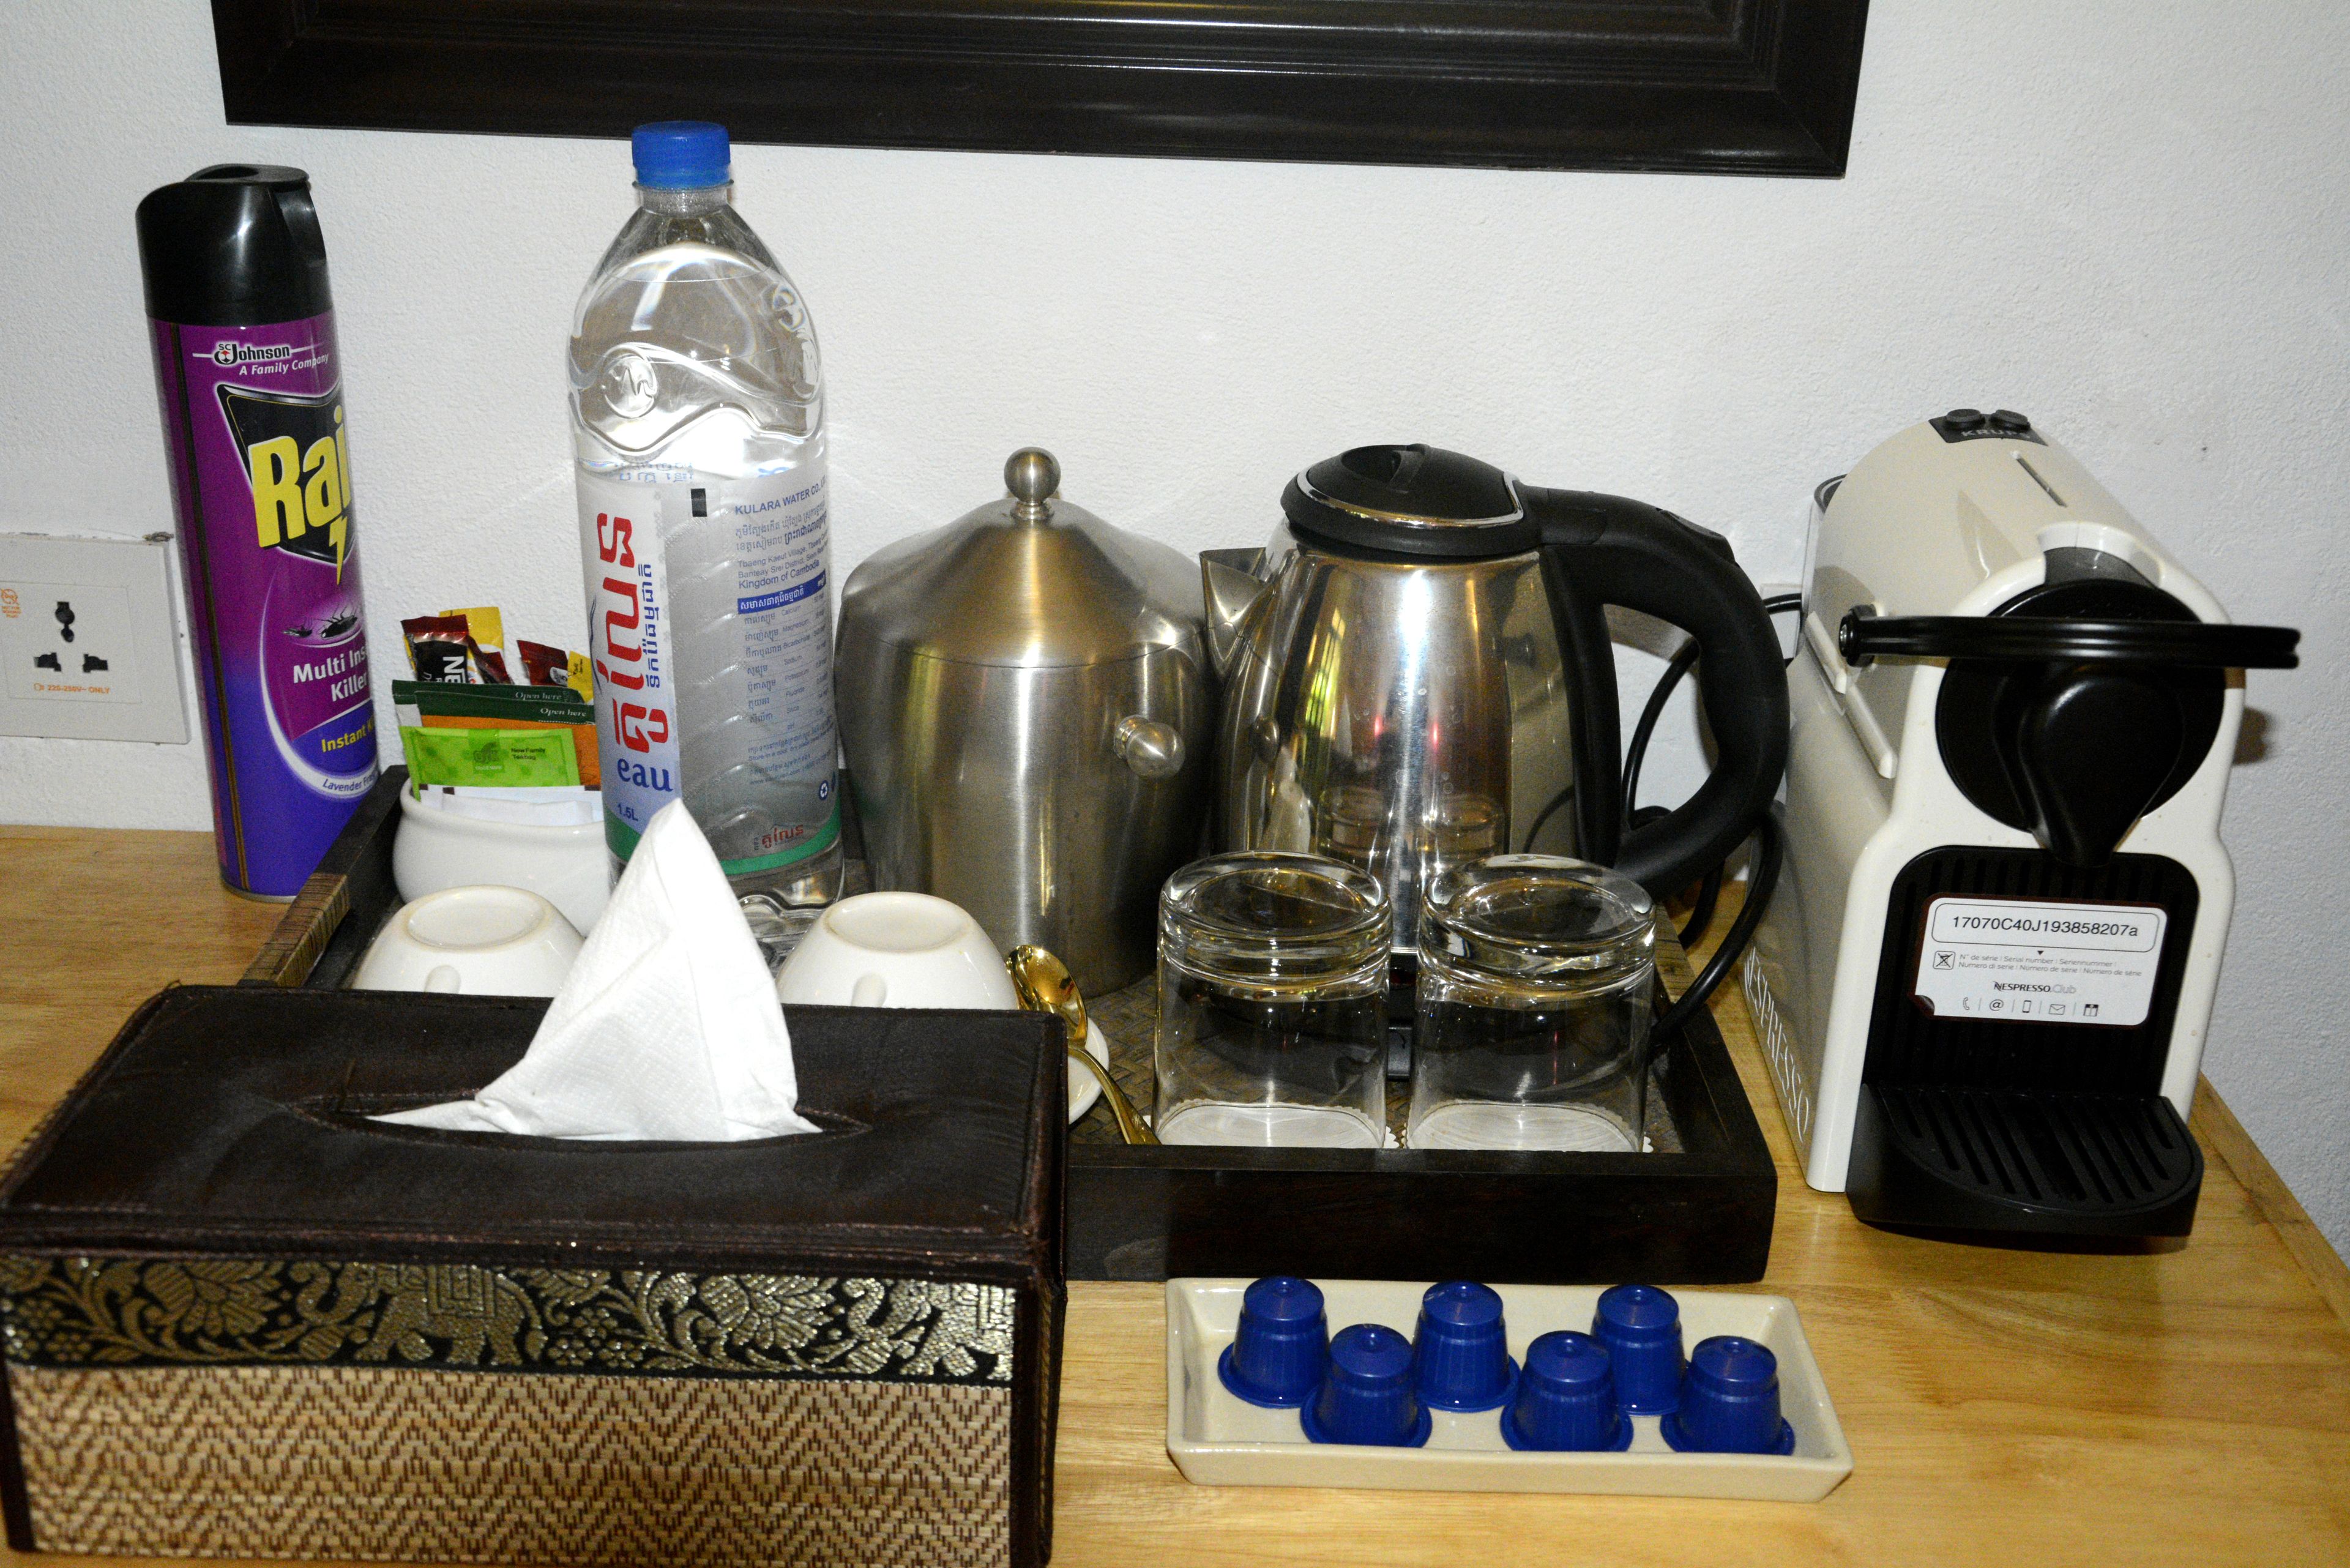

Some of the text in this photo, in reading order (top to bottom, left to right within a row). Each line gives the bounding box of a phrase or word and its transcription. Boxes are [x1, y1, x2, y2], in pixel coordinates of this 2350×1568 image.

[214, 344, 290, 365] Johnson
[239, 353, 329, 375] A Family Company
[248, 405, 352, 548] Rai
[735, 499, 781, 515] KULARA
[783, 488, 810, 506] WATER
[738, 558, 766, 568] Tbaeng
[768, 553, 787, 563] Kaeut
[739, 569, 769, 578] Banteay
[771, 565, 783, 573] Srei
[739, 559, 820, 589] Kingdom of Cambodia
[294, 646, 367, 684] Multi Ins
[515, 692, 539, 701] Open
[540, 707, 564, 717] Open
[321, 725, 367, 753] Instant
[323, 778, 362, 791] Lavender
[617, 758, 673, 792] eau
[617, 804, 638, 821] 1.5L
[1953, 916, 2138, 937] 17070C40J193858207a
